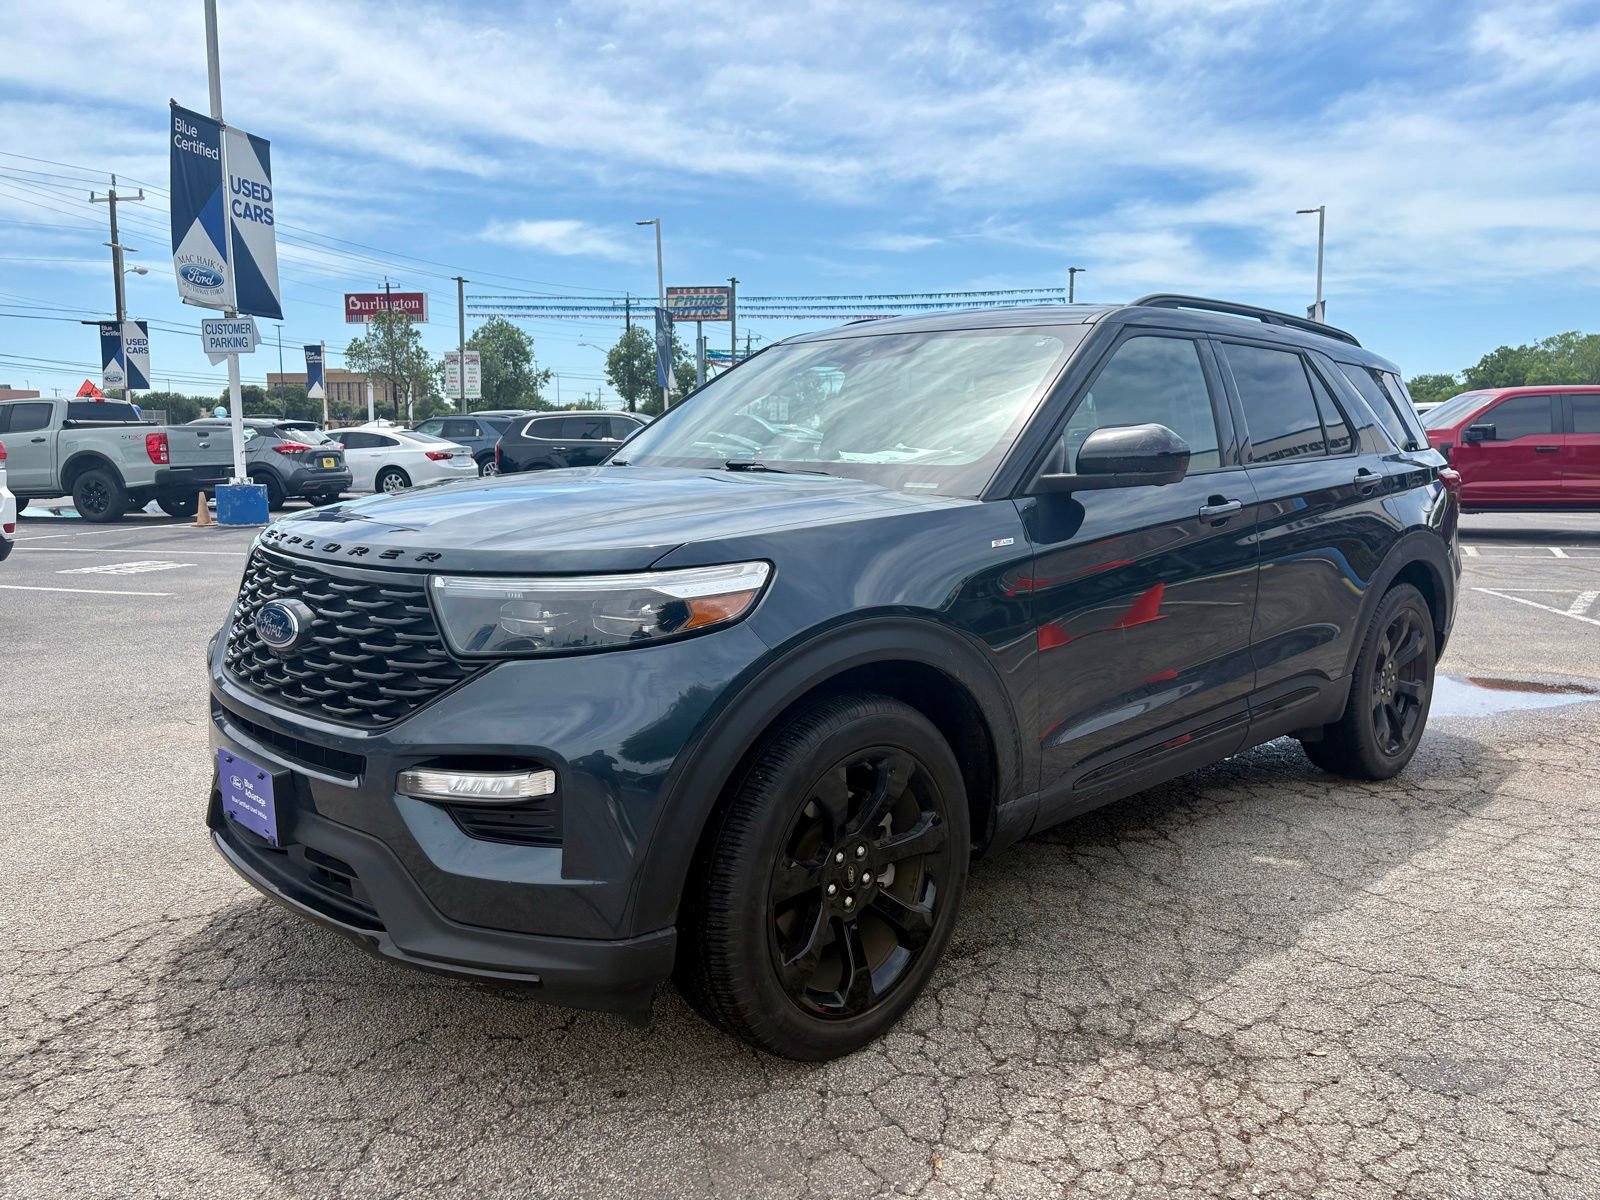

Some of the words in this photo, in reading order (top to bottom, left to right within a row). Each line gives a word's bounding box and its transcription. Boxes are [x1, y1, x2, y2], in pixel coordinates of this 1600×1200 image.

[174, 117, 198, 138] Blue
[174, 134, 219, 160] Certified
[230, 174, 273, 203] USED
[231, 199, 274, 226] CARS
[178, 254, 195, 265] MAC
[196, 255, 224, 274] HAIK'S
[187, 267, 215, 286] Ford
[349, 296, 419, 312] Burlington
[674, 294, 725, 307] PRIMO
[205, 323, 251, 335] CUSTOMER
[126, 338, 149, 346] USED
[210, 336, 249, 348] PARKING
[265, 529, 443, 563] EXPLORER
[260, 612, 284, 639] Ford
